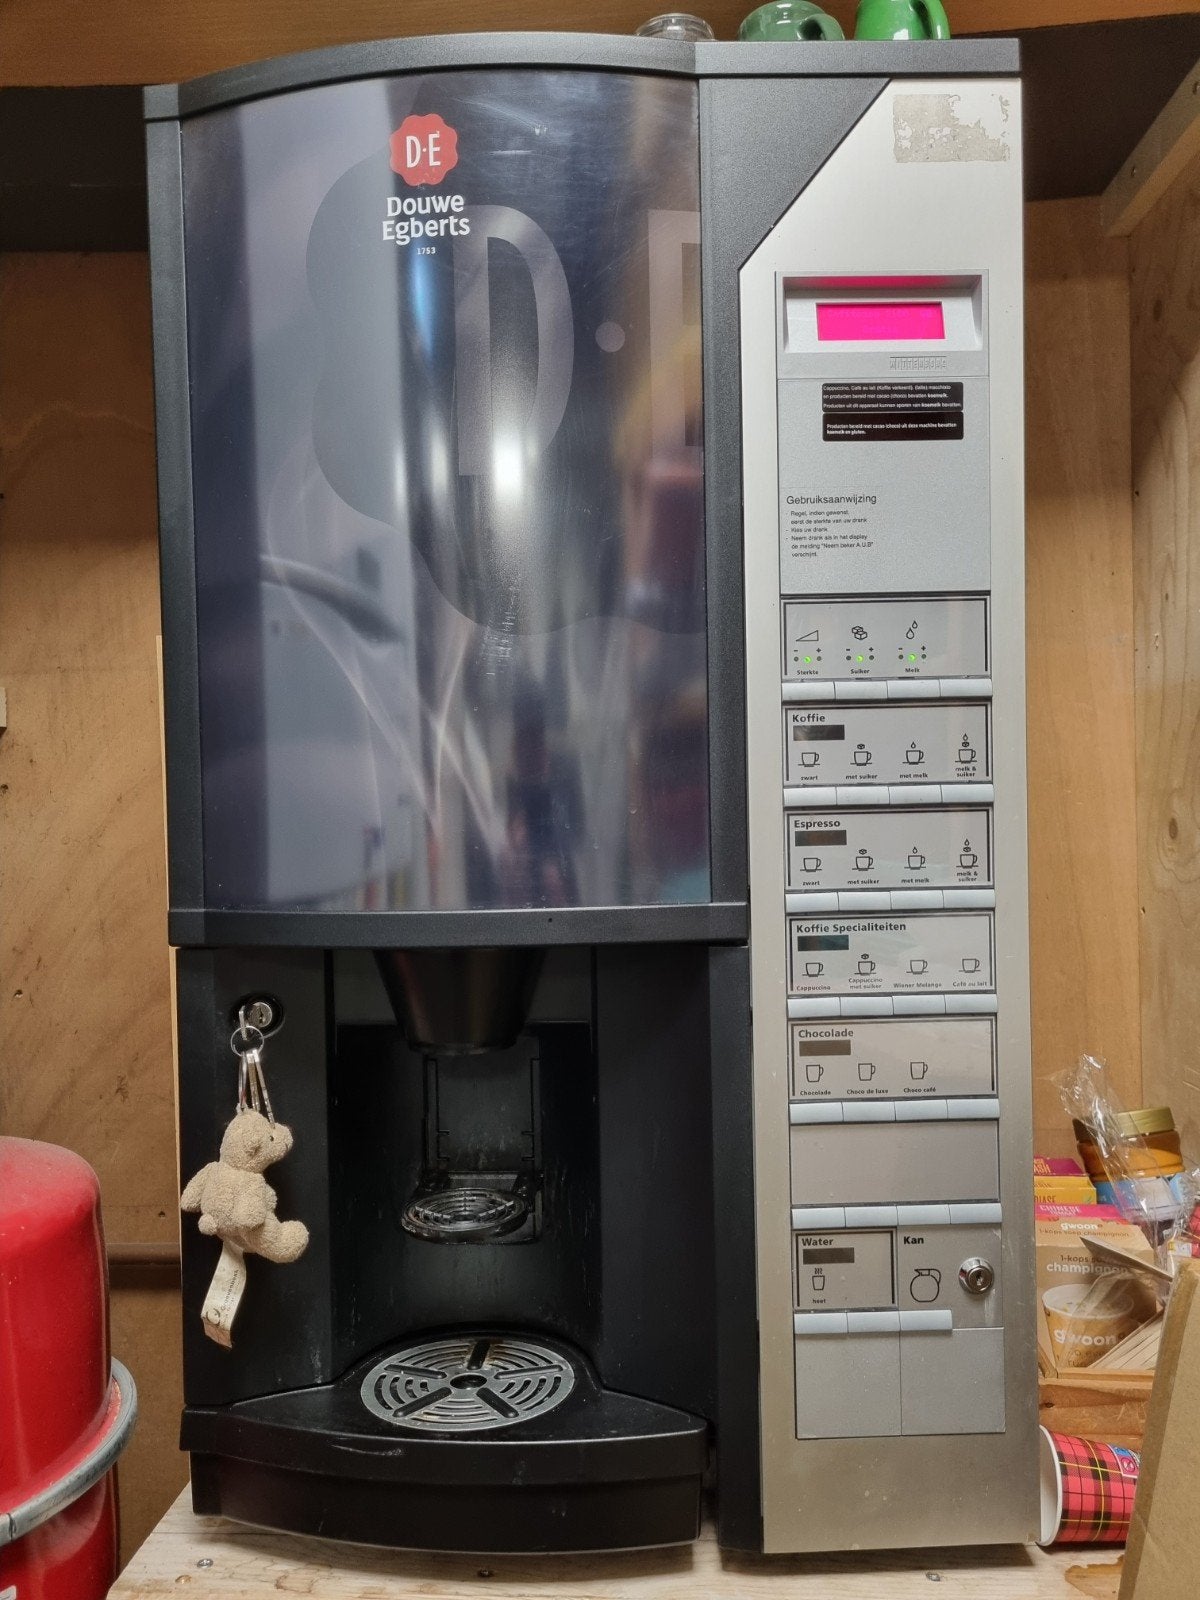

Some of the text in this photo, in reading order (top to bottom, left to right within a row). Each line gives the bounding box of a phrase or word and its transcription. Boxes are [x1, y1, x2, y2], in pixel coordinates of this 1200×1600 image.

[387, 194, 464, 217] Douwe
[382, 216, 471, 246] Egberts
[417, 246, 436, 255] 1753
[786, 494, 877, 505] Gebruiksaanwijzing
[792, 714, 826, 723] Koffie
[794, 819, 841, 829] Espresso
[796, 922, 907, 934] Koffie Specialiteiten
[798, 1029, 854, 1038] Chocolade
[1061, 1222, 1098, 1230] gwoon
[801, 1236, 924, 1246] Water Kan
[1060, 1254, 1089, 1263] 1-kops
[1046, 1262, 1128, 1275] champignon
[1054, 1329, 1117, 1346] gwoon
